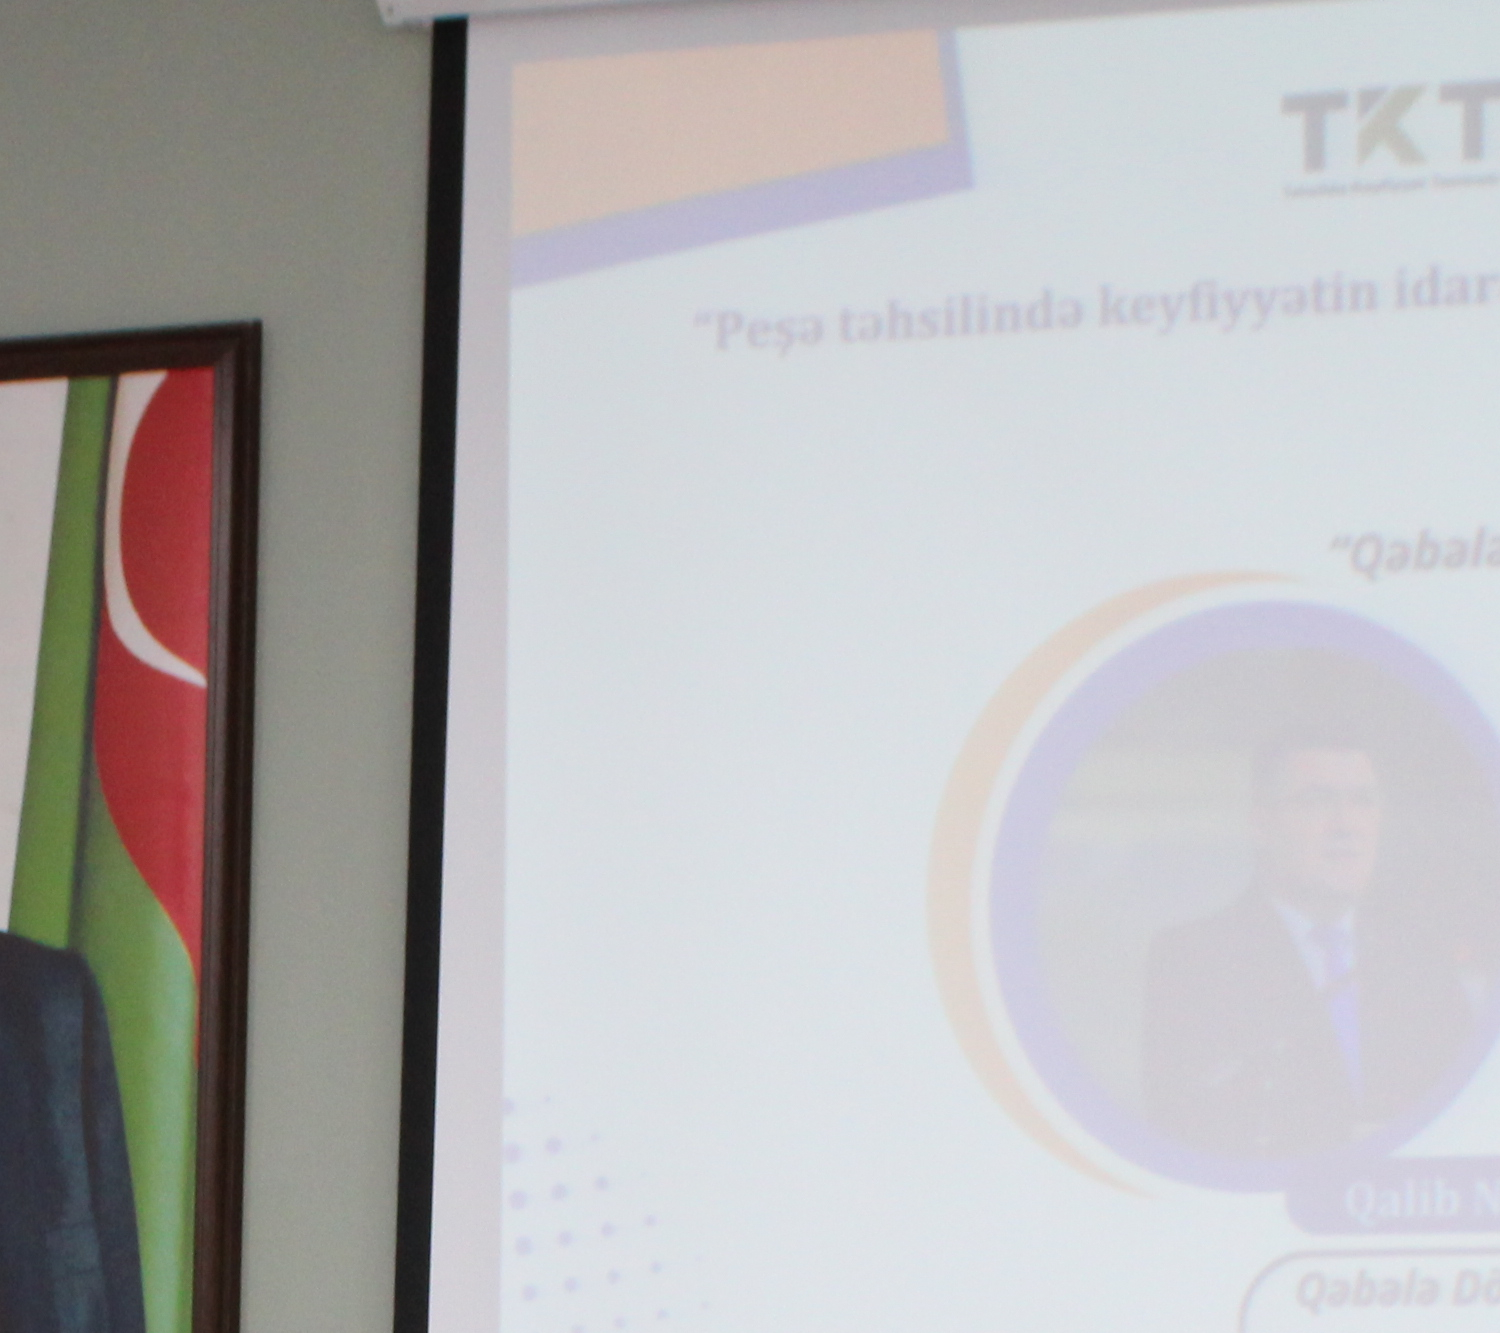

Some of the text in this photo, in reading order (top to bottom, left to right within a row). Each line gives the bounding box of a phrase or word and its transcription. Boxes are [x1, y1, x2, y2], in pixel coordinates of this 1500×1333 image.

[838, 286, 1084, 345] təhsilində
[1101, 272, 1380, 336] keyfiyyətin
[1344, 1175, 1461, 1228] Qalib
[1297, 1268, 1442, 1317] Qəbələ
